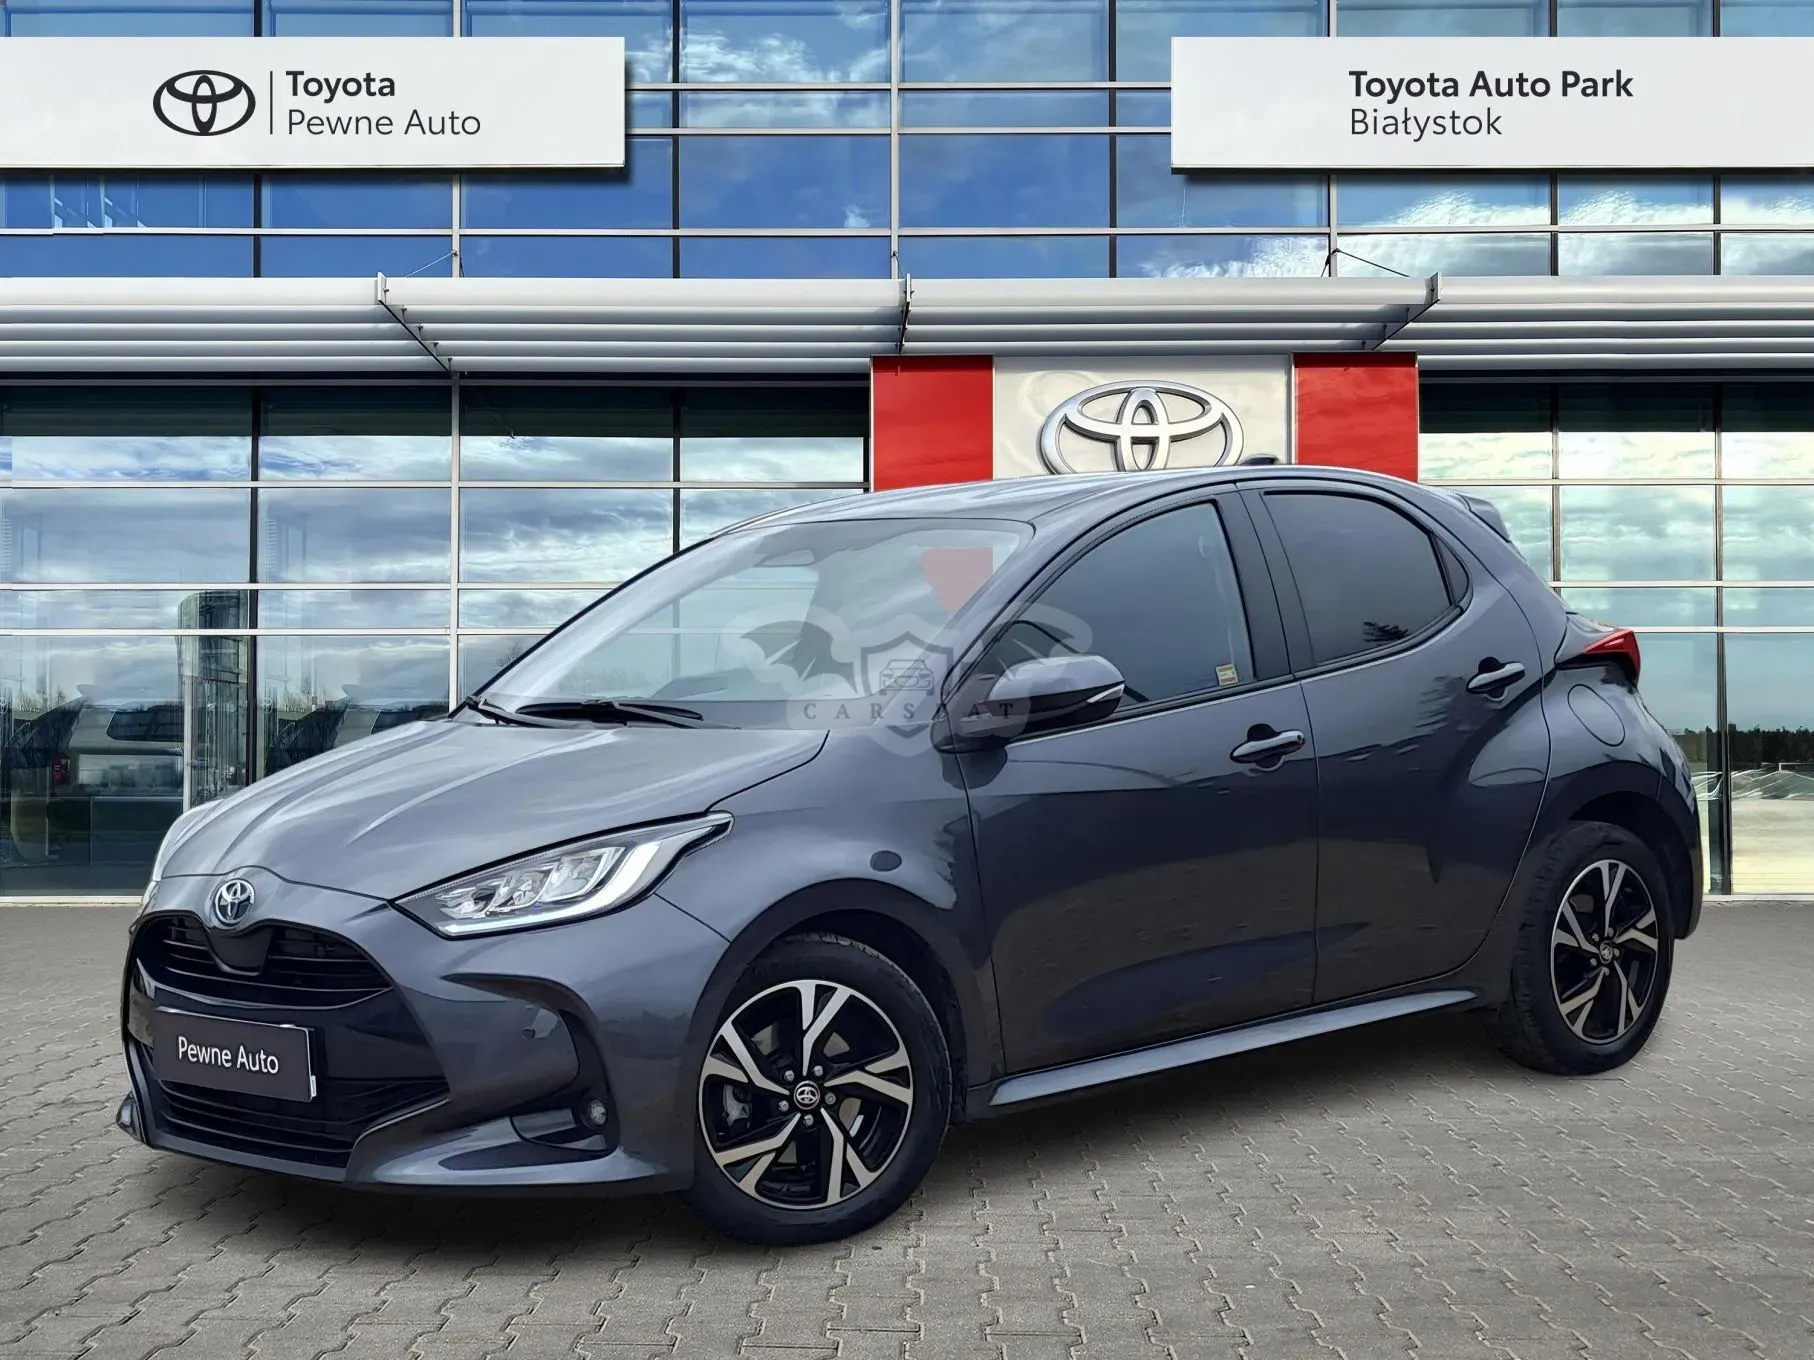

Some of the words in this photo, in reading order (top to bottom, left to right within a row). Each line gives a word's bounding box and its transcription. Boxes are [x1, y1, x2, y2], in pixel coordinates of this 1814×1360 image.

[286, 71, 395, 103] Toyota
[1349, 71, 1458, 104] Toyota
[1469, 71, 1550, 97] Auto
[1562, 70, 1633, 97] Park
[288, 109, 393, 135] Pewne
[404, 109, 481, 135] Auto
[1351, 107, 1502, 142] Białystok
[178, 1036, 232, 1067] Pewne
[236, 1045, 279, 1074] Auto
